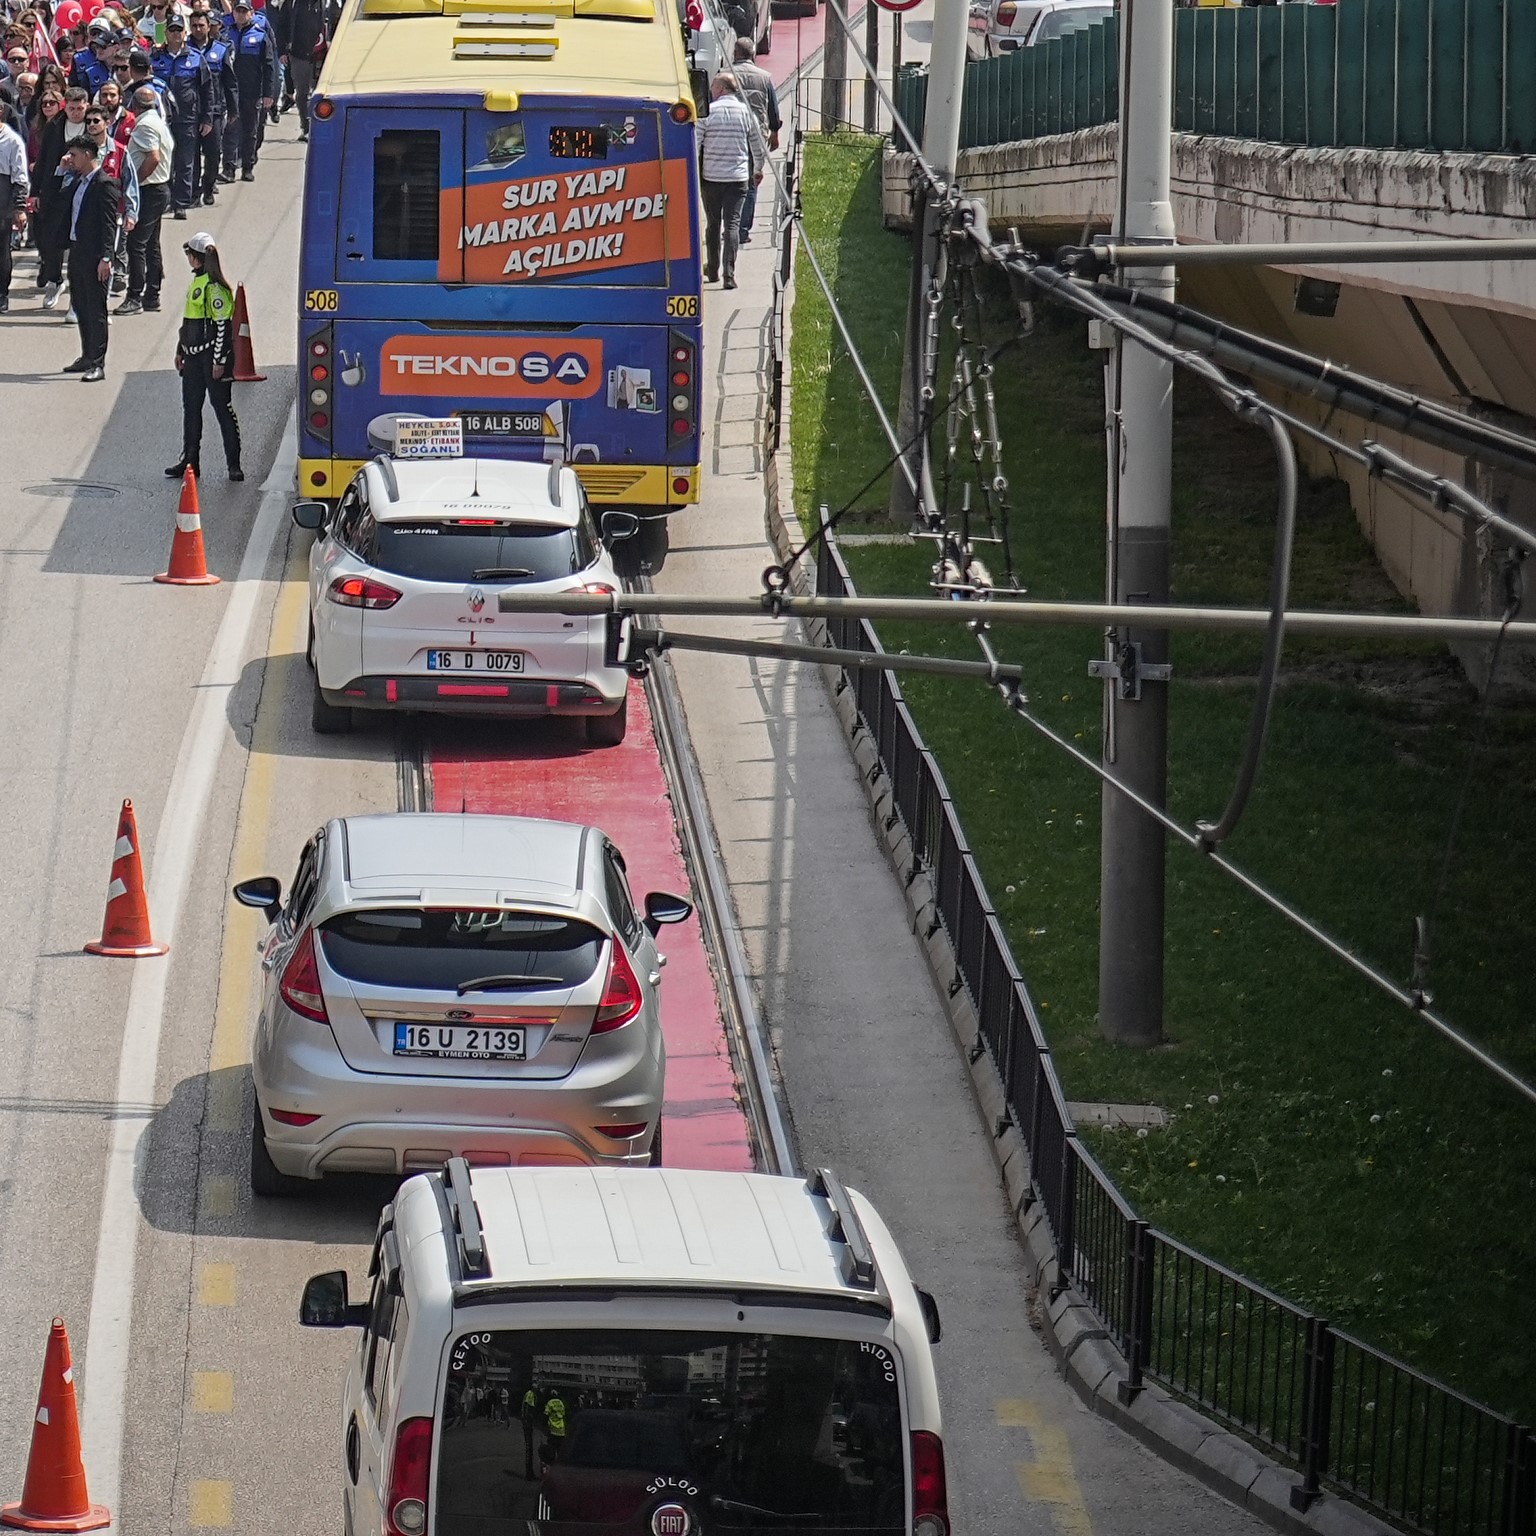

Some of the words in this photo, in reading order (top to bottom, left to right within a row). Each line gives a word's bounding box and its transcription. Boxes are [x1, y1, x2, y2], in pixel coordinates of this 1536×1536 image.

[501, 183, 556, 210] SUR
[563, 167, 627, 199] YAPI
[457, 213, 557, 250] MARKA
[502, 232, 624, 277] AÇILDIK!
[305, 290, 339, 311] 508
[667, 295, 699, 317] 508
[390, 354, 588, 380] TEKNOSA
[399, 421, 435, 429] HEYKEL
[466, 417, 480, 431] 16
[484, 416, 512, 431] ALB
[515, 416, 540, 431] 508
[400, 444, 461, 454] SOĞANLI
[430, 437, 460, 445] ETİBANK
[457, 616, 495, 624] CLIO
[437, 652, 452, 668] 16
[464, 653, 474, 669] D
[486, 653, 522, 670] 0079
[407, 1026, 431, 1048] 16
[438, 1028, 454, 1049] U
[466, 1029, 521, 1052] 2139
[438, 1050, 470, 1059] EYMEN
[471, 1051, 491, 1059] OTO
[452, 1332, 492, 1371] ÇETOO
[859, 1341, 896, 1383] HIDOO
[645, 1476, 698, 1496] SÜLOO
[660, 1515, 683, 1533] FIAT
